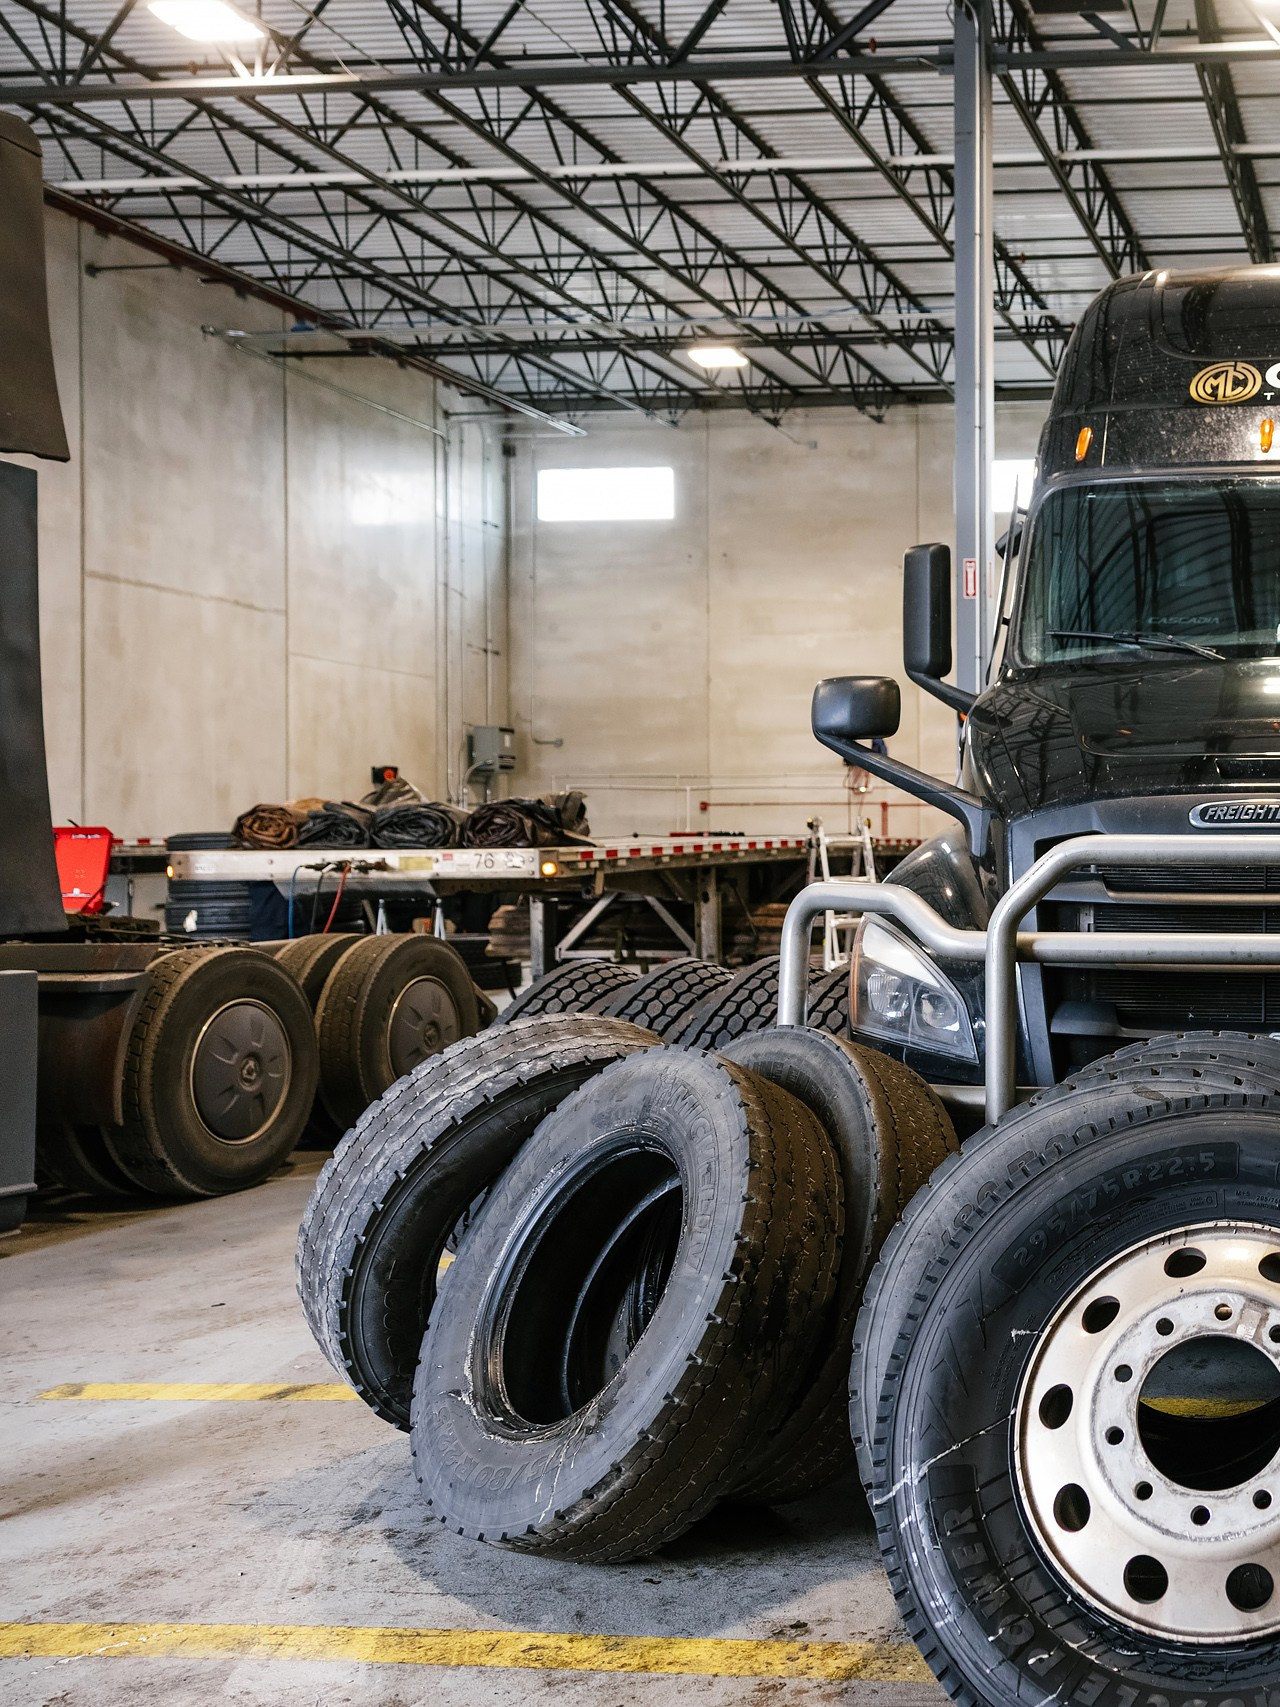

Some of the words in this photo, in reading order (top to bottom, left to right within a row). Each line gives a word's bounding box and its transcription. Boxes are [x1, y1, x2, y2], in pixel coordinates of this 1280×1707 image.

[668, 1083, 718, 1271] MICHELIN
[1013, 1151, 1216, 1268] 295/75R22.5
[943, 1504, 1067, 1680] POWER
